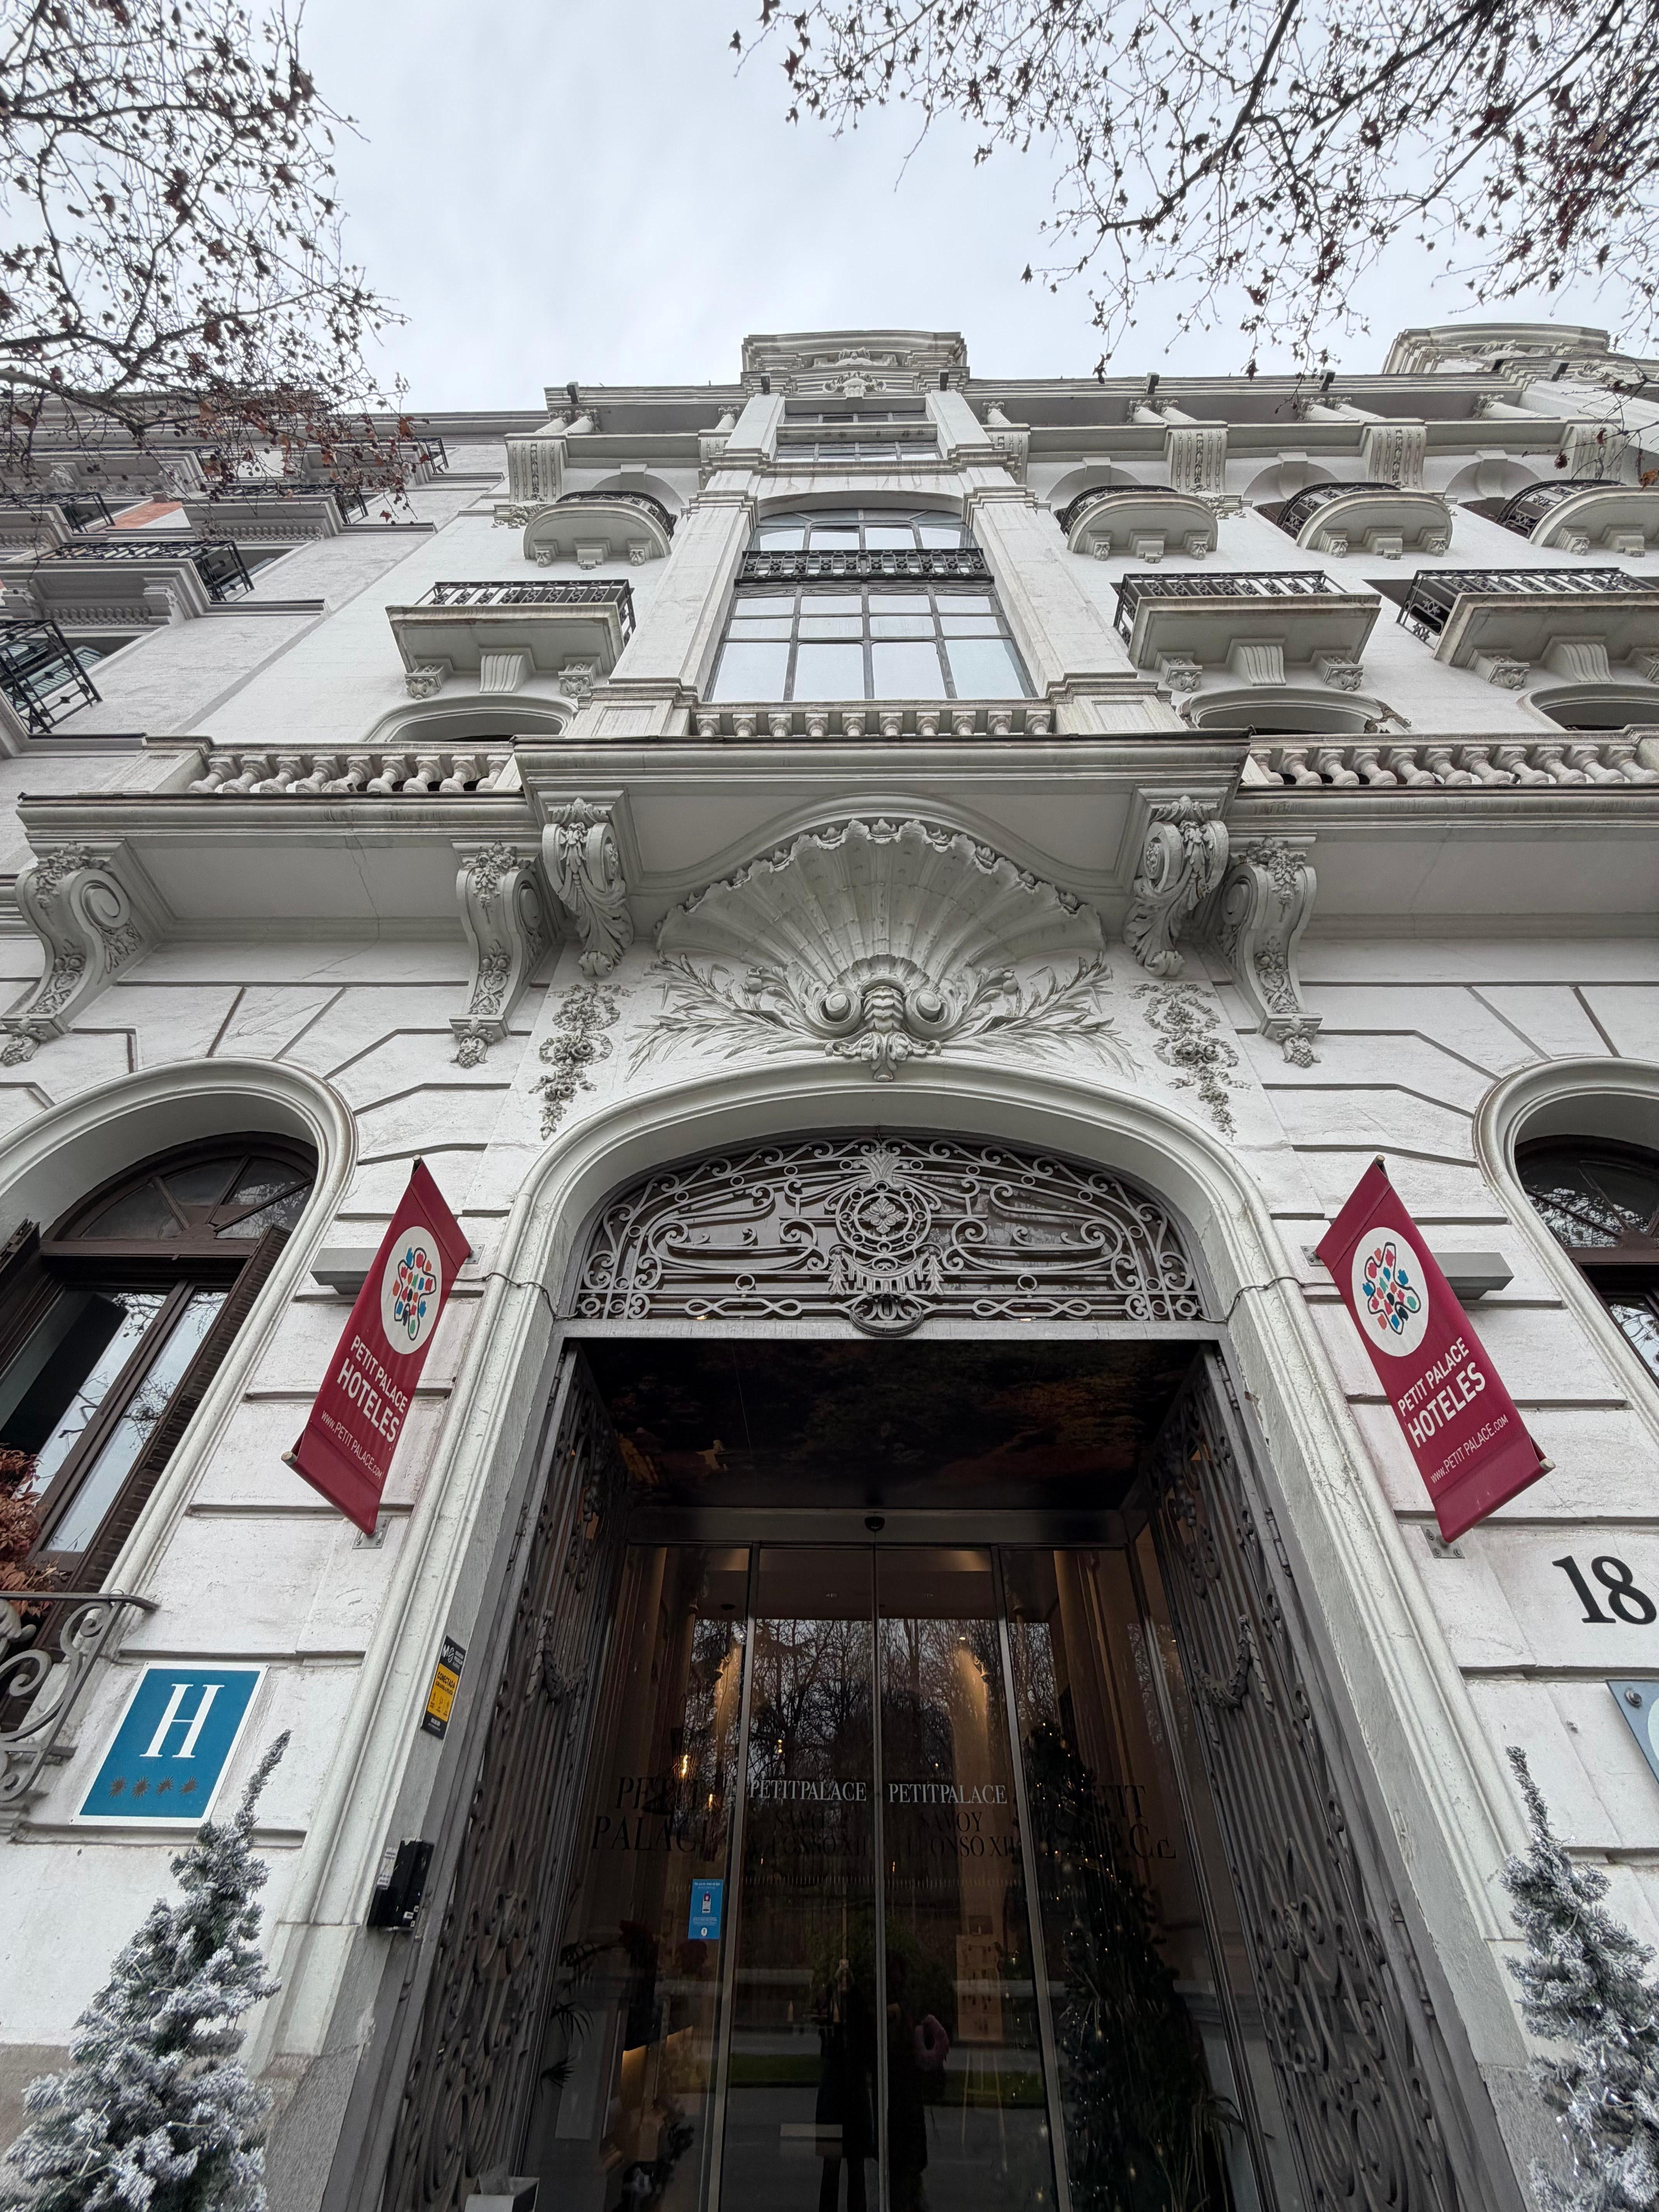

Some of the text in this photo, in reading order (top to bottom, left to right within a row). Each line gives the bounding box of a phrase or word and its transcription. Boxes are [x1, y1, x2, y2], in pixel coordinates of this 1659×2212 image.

[337, 1358, 400, 1442] HOTELES
[350, 1335, 408, 1413] PETIT PALACE
[1397, 1337, 1469, 1417] PETIT PALACE
[1407, 1362, 1486, 1448] HOTELES
[1552, 1555, 1657, 1624] 18
[139, 1683, 225, 1757] H
[615, 1777, 702, 1809] PET
[749, 1780, 867, 1801] PETITPALACE
[888, 1784, 1007, 1804] PETITPALACE
